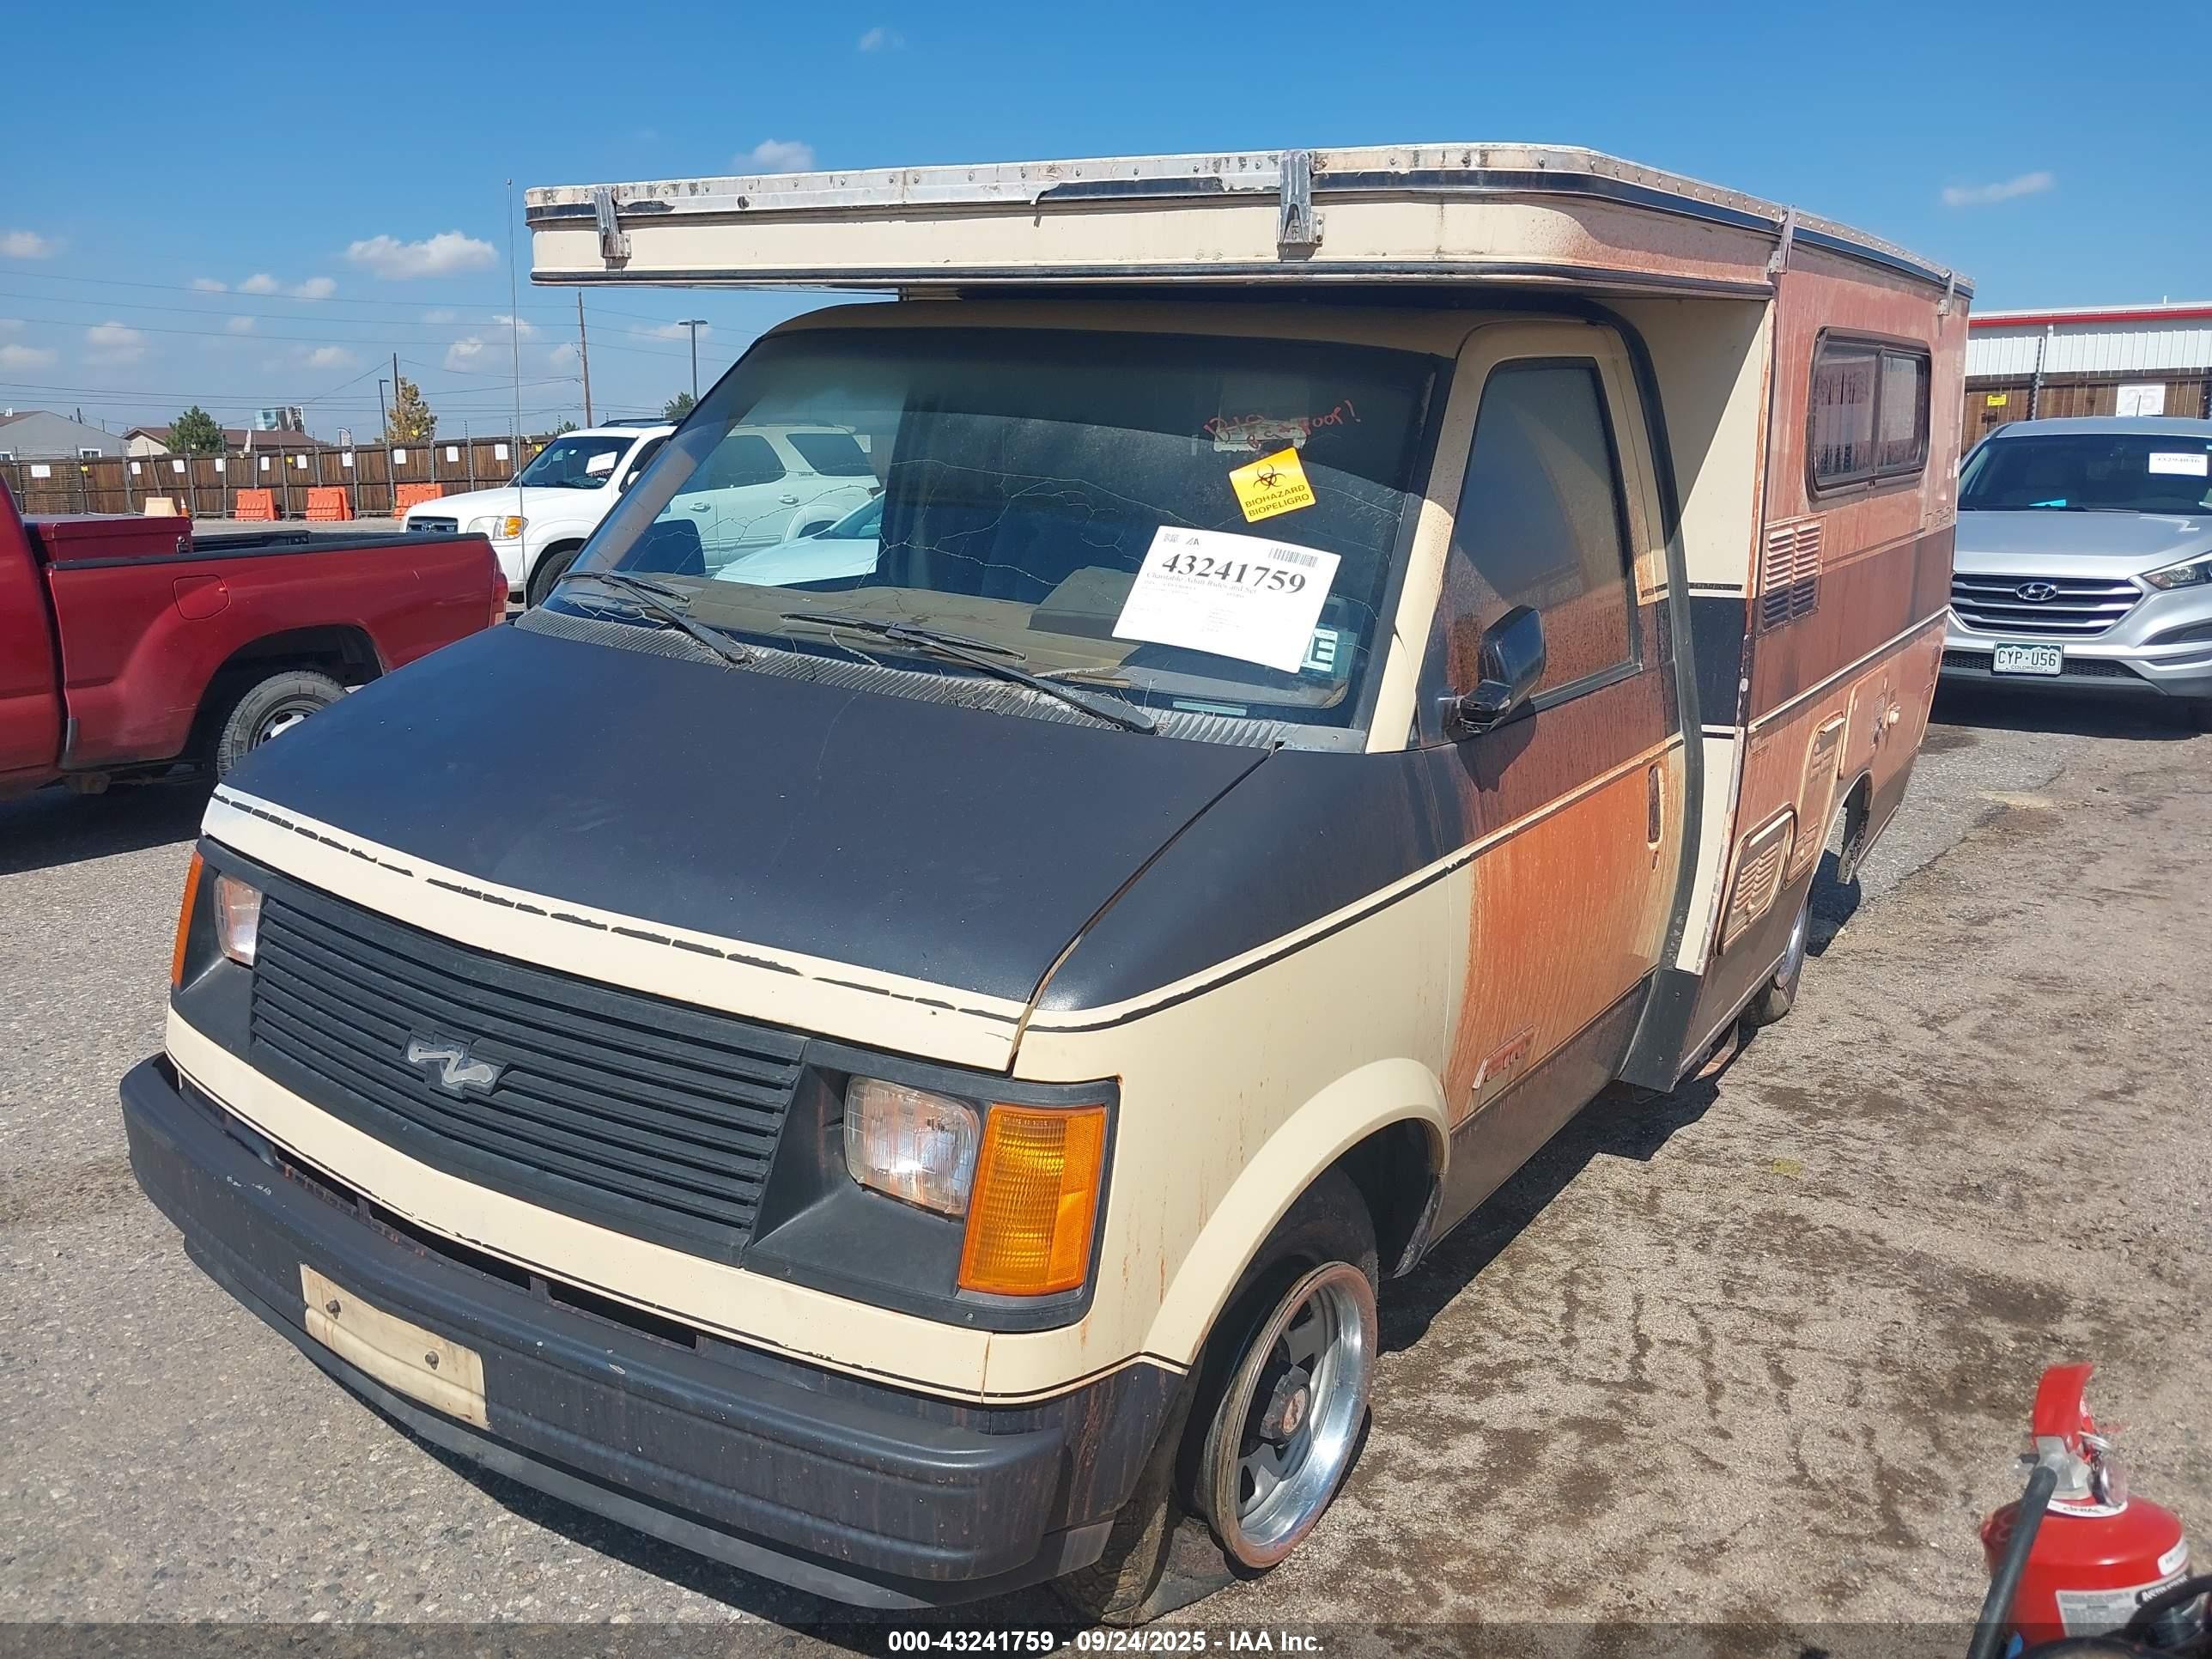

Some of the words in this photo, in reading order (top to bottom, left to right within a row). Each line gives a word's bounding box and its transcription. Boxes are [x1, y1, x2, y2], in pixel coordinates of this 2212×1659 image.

[2124, 389, 2157, 410] 25
[1244, 484, 1305, 508] BIOHAZARD
[1249, 493, 1310, 517] BIOPELIGRO
[1162, 553, 1306, 594] 43241759
